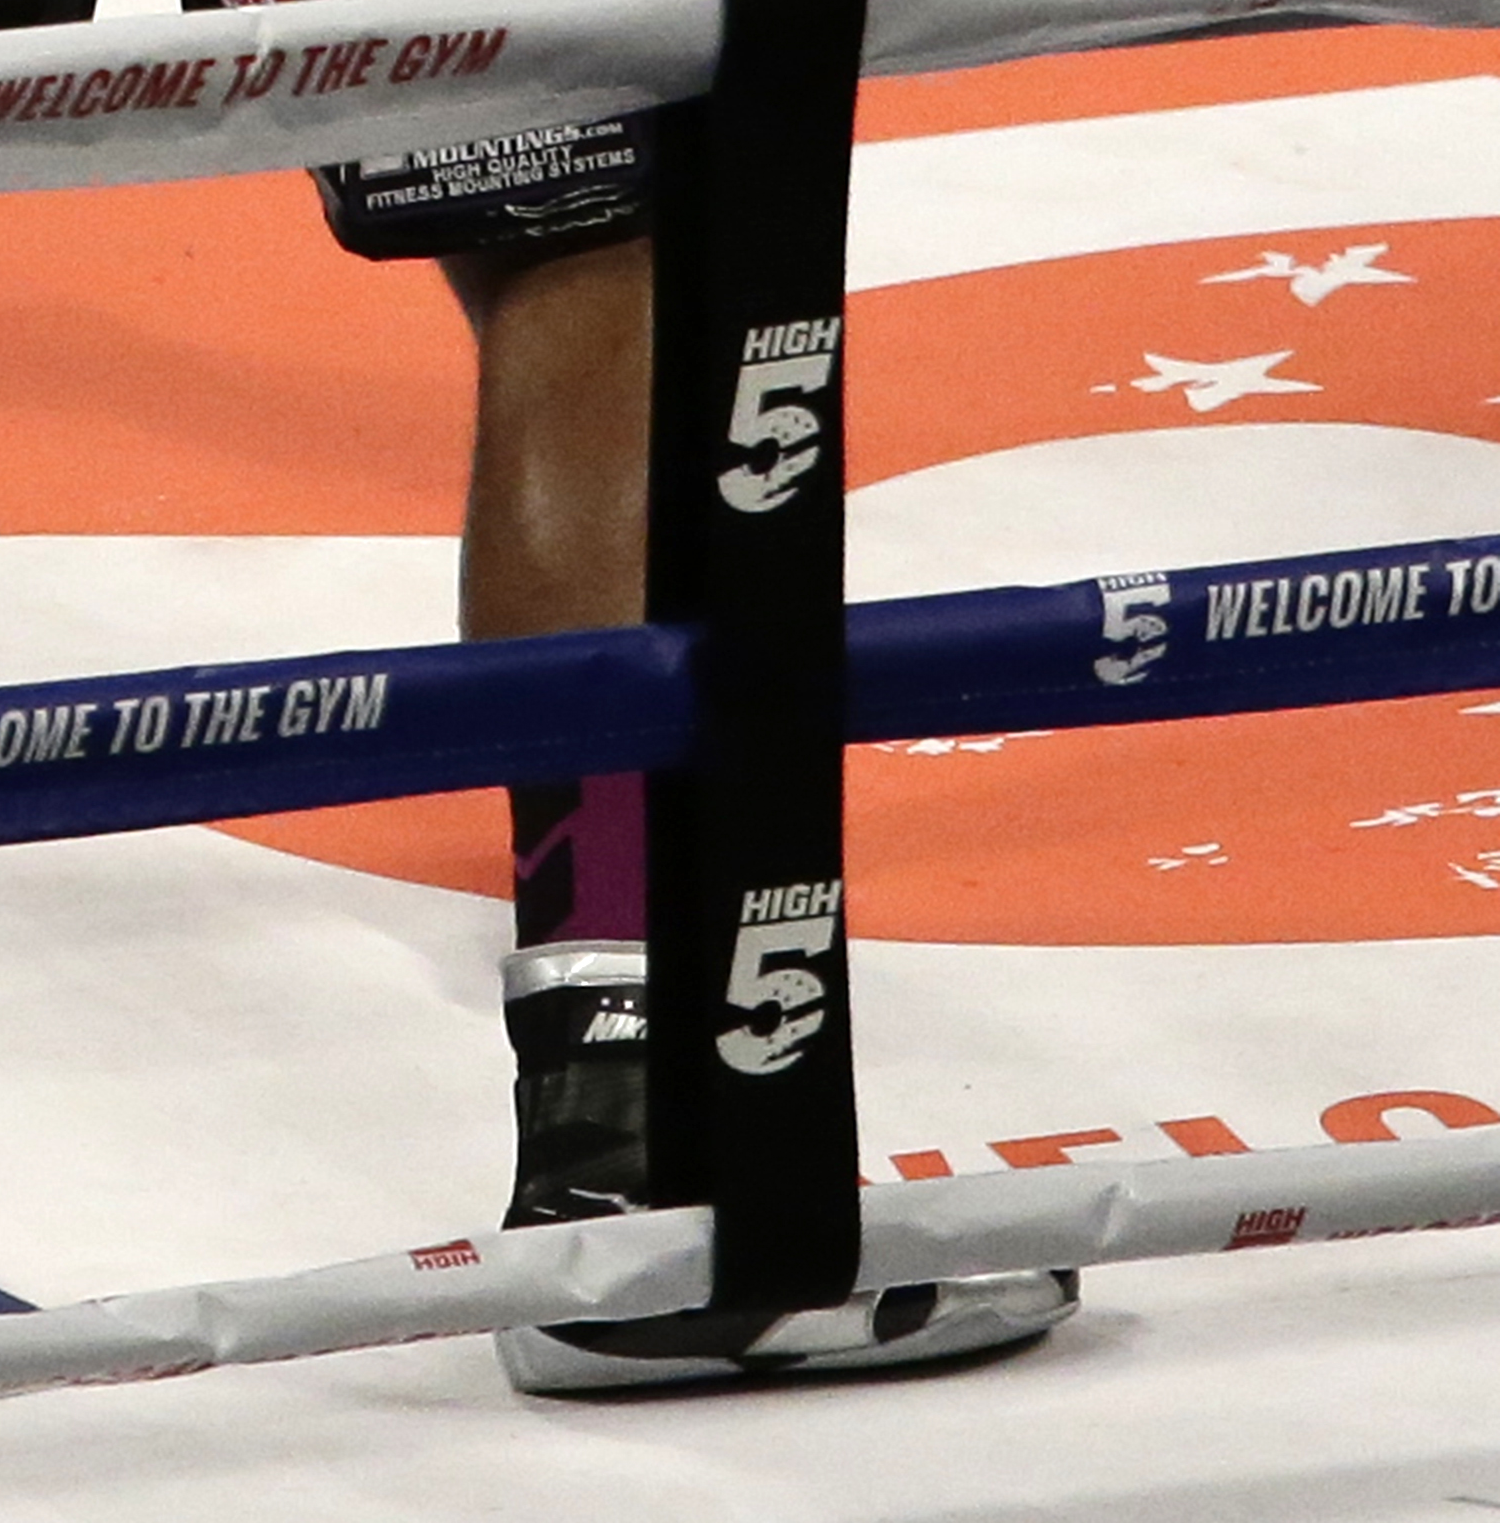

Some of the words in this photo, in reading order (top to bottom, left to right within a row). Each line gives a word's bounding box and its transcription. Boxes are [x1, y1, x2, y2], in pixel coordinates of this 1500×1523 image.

[221, 49, 289, 109] TO
[294, 37, 389, 97] THE
[388, 27, 510, 87] GYM
[365, 182, 443, 211] FITNESS
[448, 166, 544, 198] MOUNTING
[548, 147, 636, 179] SYSTEMS
[432, 161, 481, 183] HIGH
[486, 144, 575, 174] QUALITY
[742, 316, 843, 363] HIGH
[717, 352, 833, 515] 5
[1094, 582, 1172, 686] 5
[1206, 563, 1430, 642] WELCOME
[106, 695, 171, 756] TO
[181, 684, 277, 749] THE
[275, 673, 390, 737] GYM
[741, 879, 845, 925] HIGH
[583, 1012, 647, 1044] NIK
[716, 915, 836, 1076] 5
[1235, 1205, 1308, 1234] HIGH
